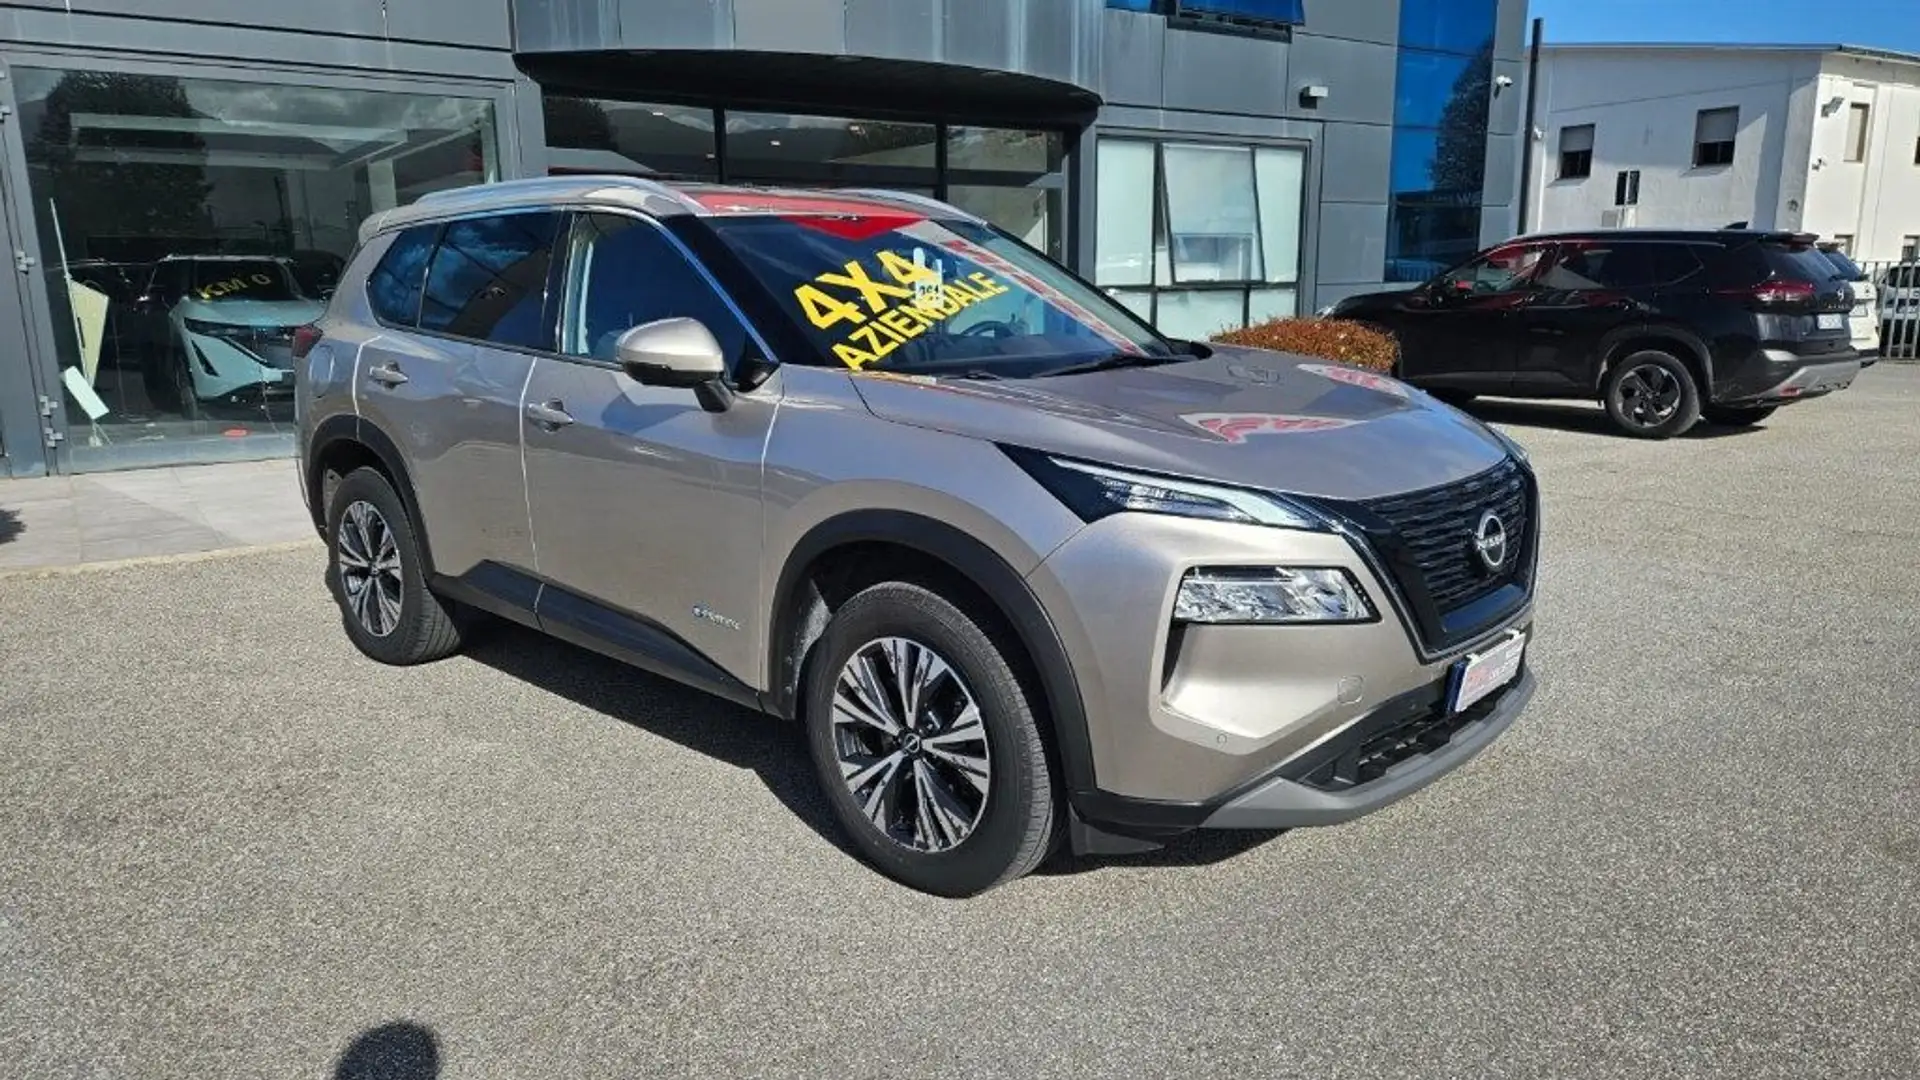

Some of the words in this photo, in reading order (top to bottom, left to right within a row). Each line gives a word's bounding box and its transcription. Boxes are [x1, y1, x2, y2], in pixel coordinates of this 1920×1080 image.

[196, 277, 249, 299] KM
[794, 250, 941, 330] 4X4
[831, 271, 1009, 371] AZIENDALE
